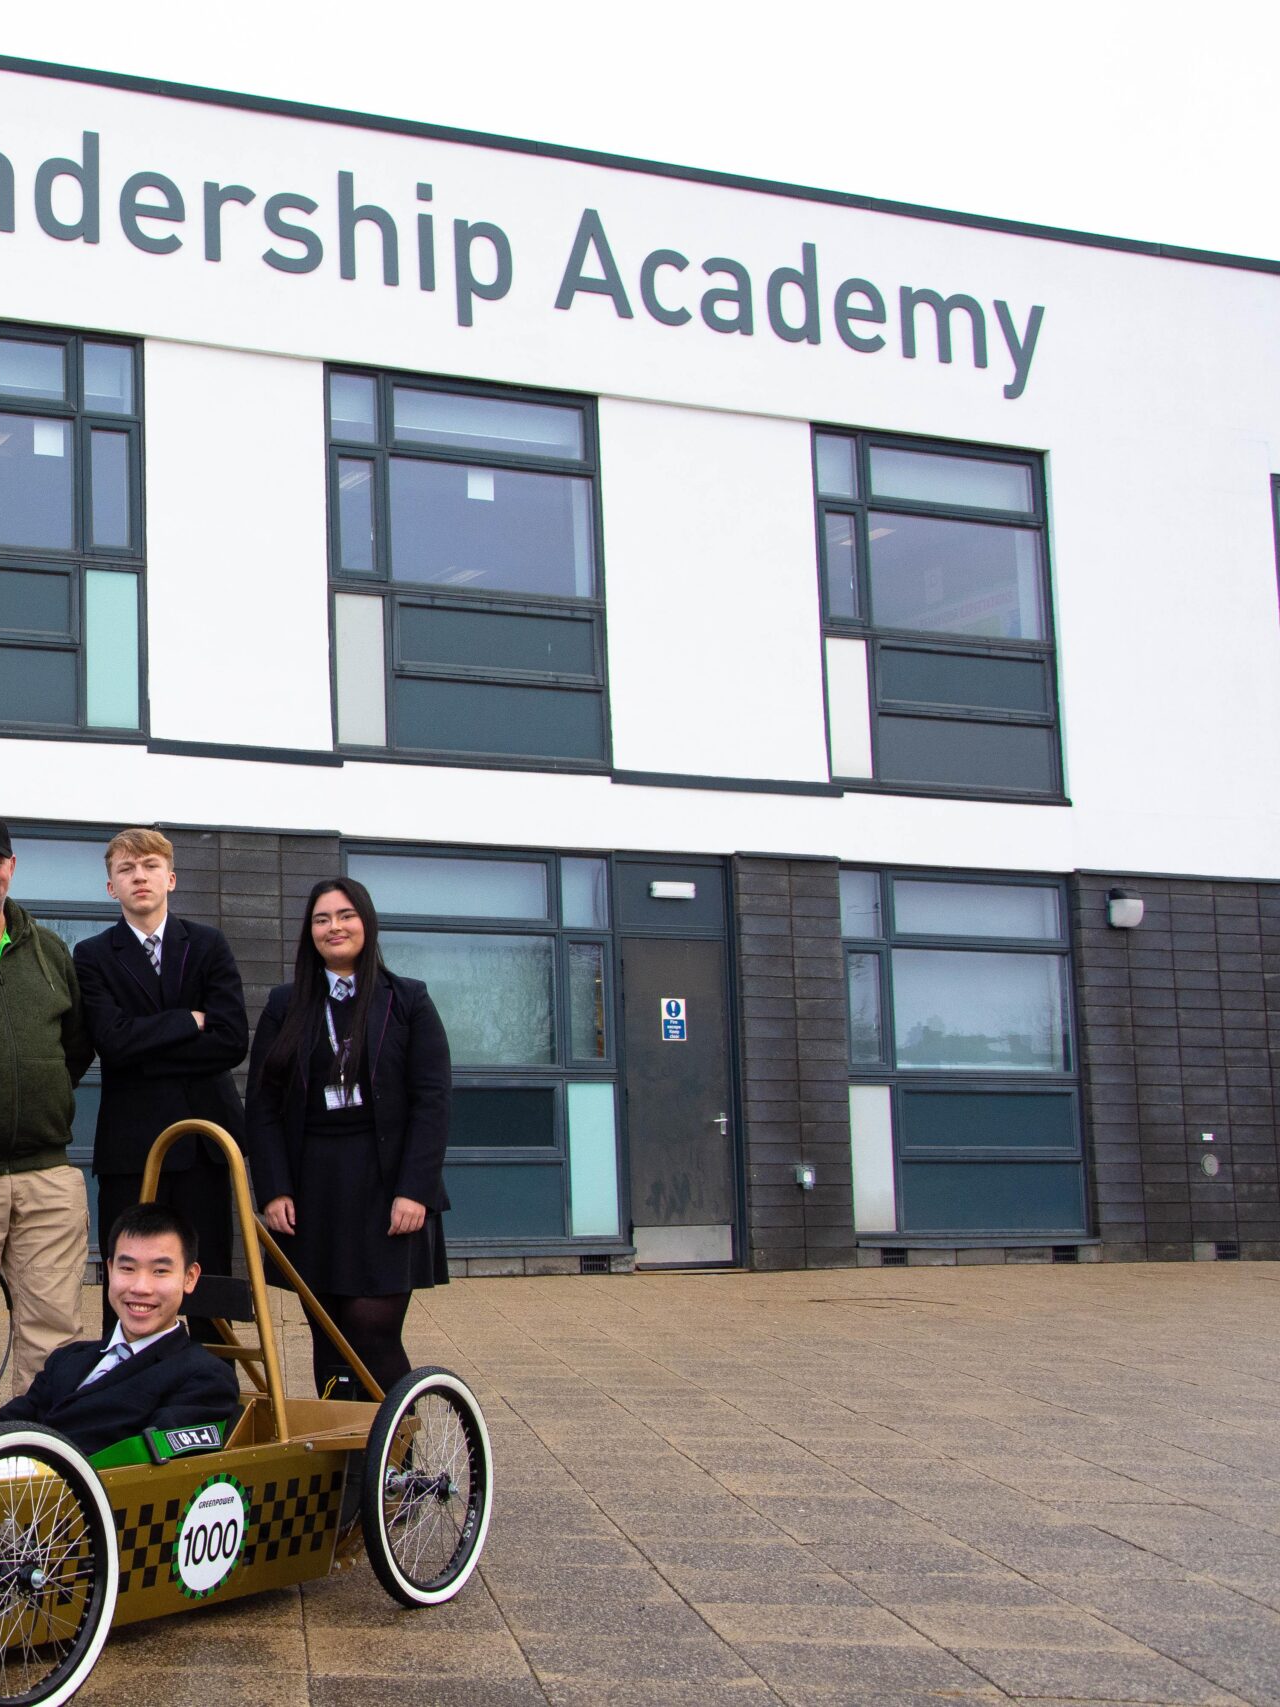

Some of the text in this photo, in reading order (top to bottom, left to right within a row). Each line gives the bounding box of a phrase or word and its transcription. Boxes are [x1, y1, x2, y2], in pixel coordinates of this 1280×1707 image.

[554, 208, 1046, 400] Academy
[198, 1496, 235, 1509] GREENPOWER
[183, 1518, 238, 1567] 1000
